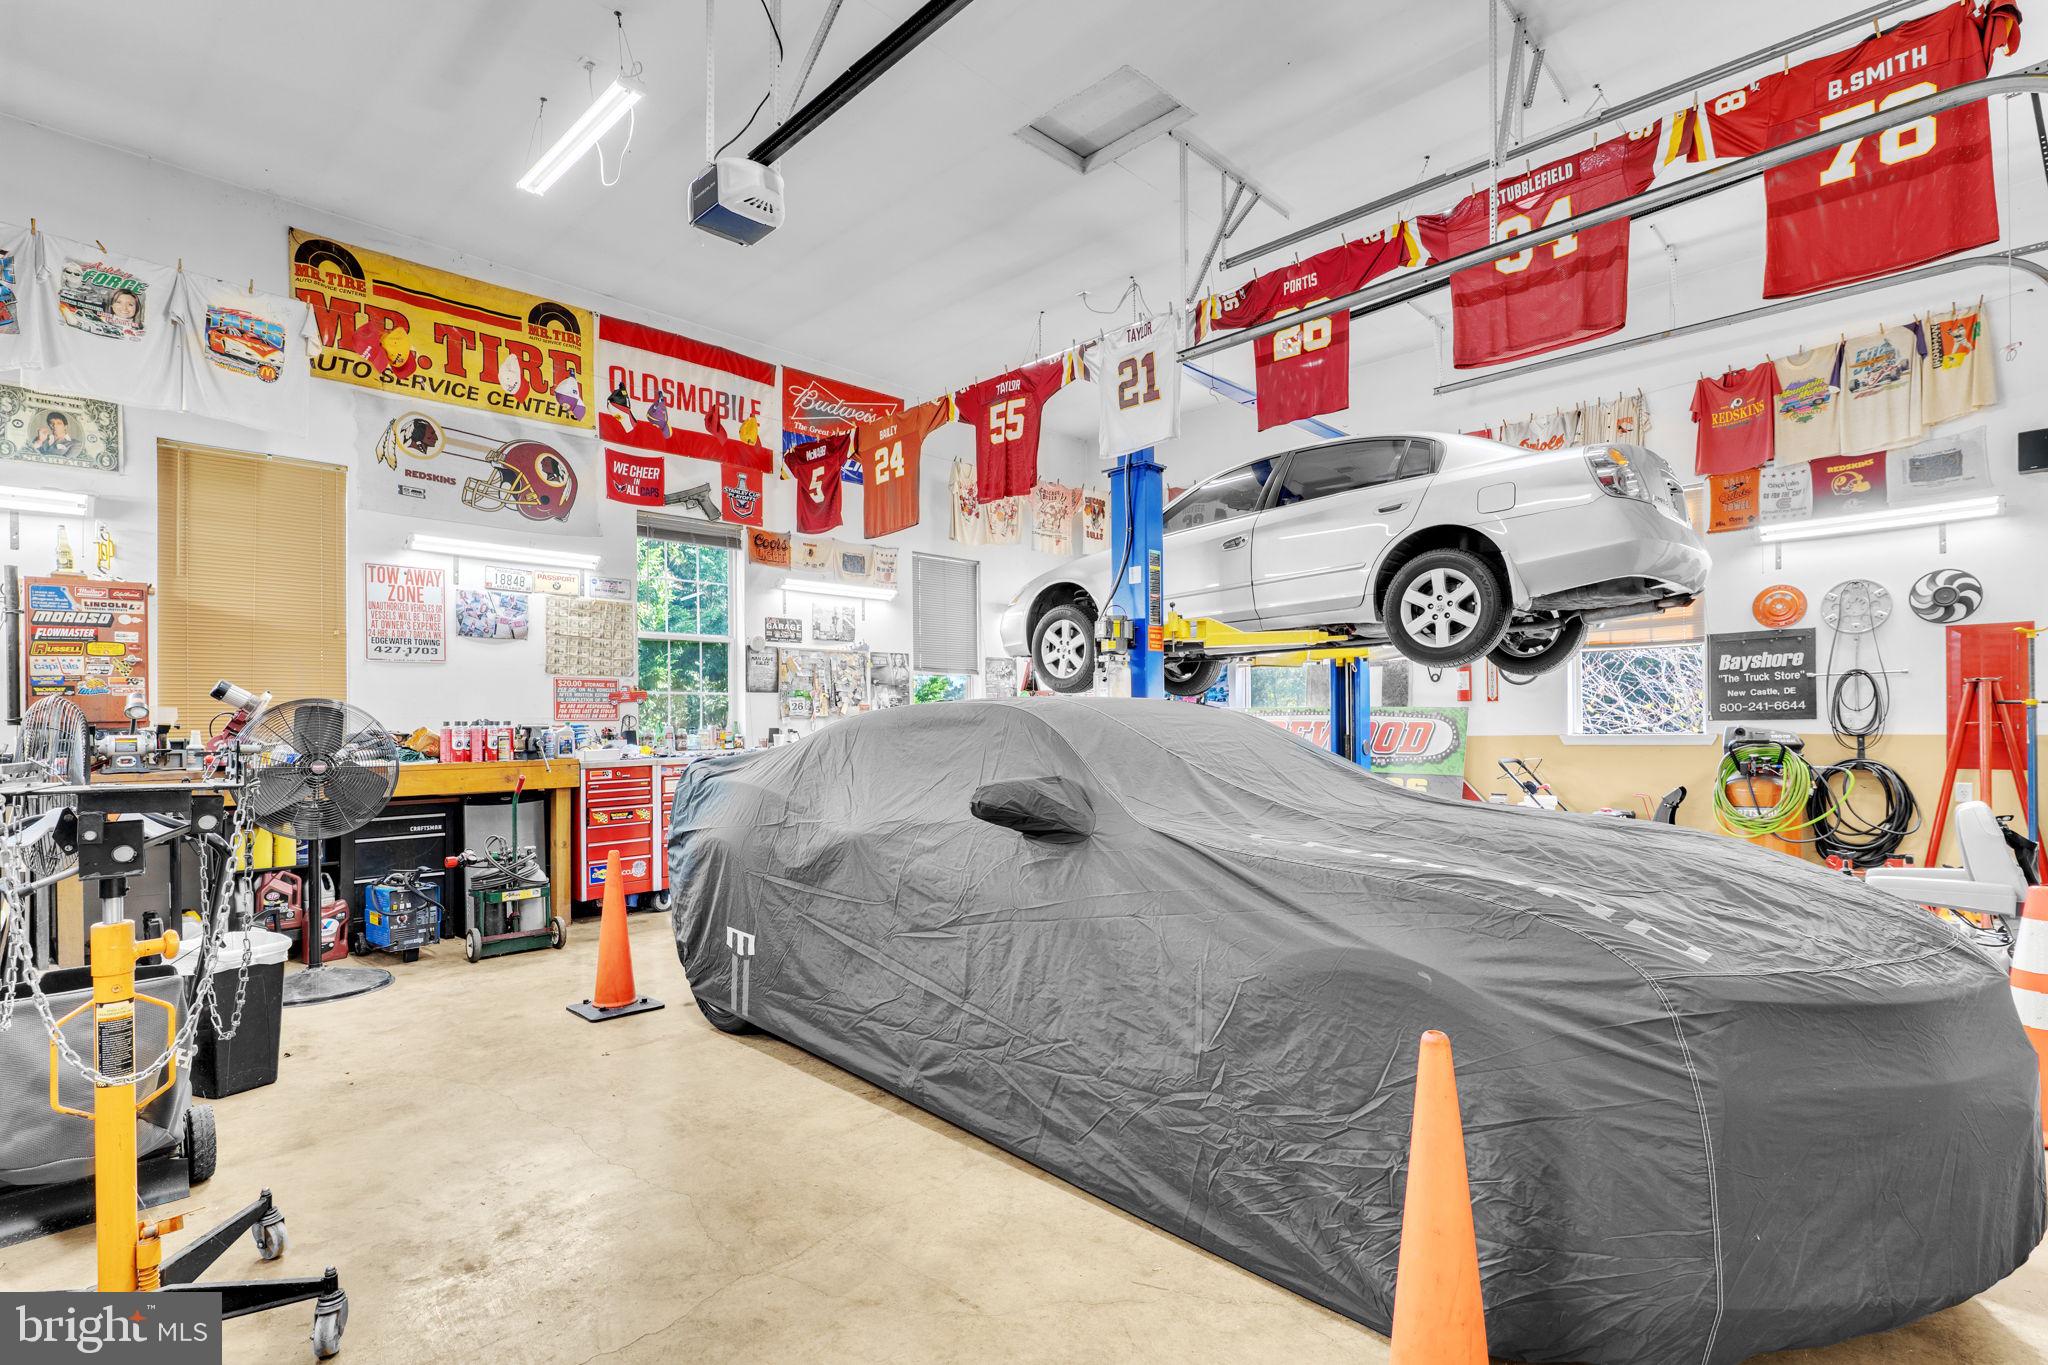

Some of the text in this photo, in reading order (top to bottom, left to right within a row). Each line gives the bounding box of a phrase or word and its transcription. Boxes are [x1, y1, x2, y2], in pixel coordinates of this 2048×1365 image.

[1828, 45, 1927, 101] B.SMITH
[81, 269, 150, 295] FORCE
[294, 263, 367, 293] MR. TIRE
[1283, 272, 1318, 296] PORTIS
[528, 323, 582, 348] MR. TIRE
[1126, 321, 1153, 344] TAYLOR
[1931, 323, 1944, 370] IRONMAN
[434, 322, 583, 397] TIRE
[996, 379, 1021, 396] TAYLOR
[1117, 351, 1162, 411] 21
[379, 368, 479, 401] SERVICE
[487, 389, 580, 421] CENTER
[609, 364, 762, 428] OLDSMOBILE
[1711, 400, 1765, 424] REDSKINS
[793, 421, 807, 431] The
[809, 425, 829, 437] Great
[989, 397, 1026, 446] 55
[22, 453, 92, 469] SCARFACE
[874, 440, 905, 486] 24
[1826, 457, 1874, 474] REDSKINS
[404, 468, 457, 486] REDSKINS
[613, 460, 661, 480] WE CHEER
[633, 477, 641, 485] IN
[808, 466, 825, 503] 5
[626, 486, 660, 498] ALL CAPS
[723, 486, 747, 498] STANLEY
[753, 532, 789, 551] Coors
[367, 565, 442, 588] TOW AWAY
[537, 573, 577, 583] PASSPORT
[387, 584, 425, 604] ZONE
[83, 600, 128, 609] LINCOLN
[368, 601, 443, 614] UNAUTHORIZED VEHICLES OR
[32, 610, 112, 624] MOROSO
[370, 610, 441, 623] VESSELS WILL BE TOWED
[34, 627, 95, 640] FLOWMASTER
[368, 629, 376, 637] 24
[391, 630, 396, 638] A
[397, 630, 408, 638] DAY
[413, 631, 427, 639] DAYS
[428, 631, 432, 639] A
[370, 619, 441, 632] AT OWNER'S EXPENSE
[766, 622, 802, 631] GARAGE
[34, 643, 81, 653] RUSSELL
[370, 636, 441, 647] EDGEWATER TOWING
[374, 645, 439, 655] 427-1703
[1718, 651, 1805, 672] Bayshore
[1718, 669, 1806, 683] "The Truck Store"
[1750, 687, 1780, 696] Castle,
[1783, 686, 1797, 695] DE
[791, 702, 804, 711] 26
[1719, 700, 1807, 713] 800-241-6644
[410, 824, 442, 832] CRAFTSMAN
